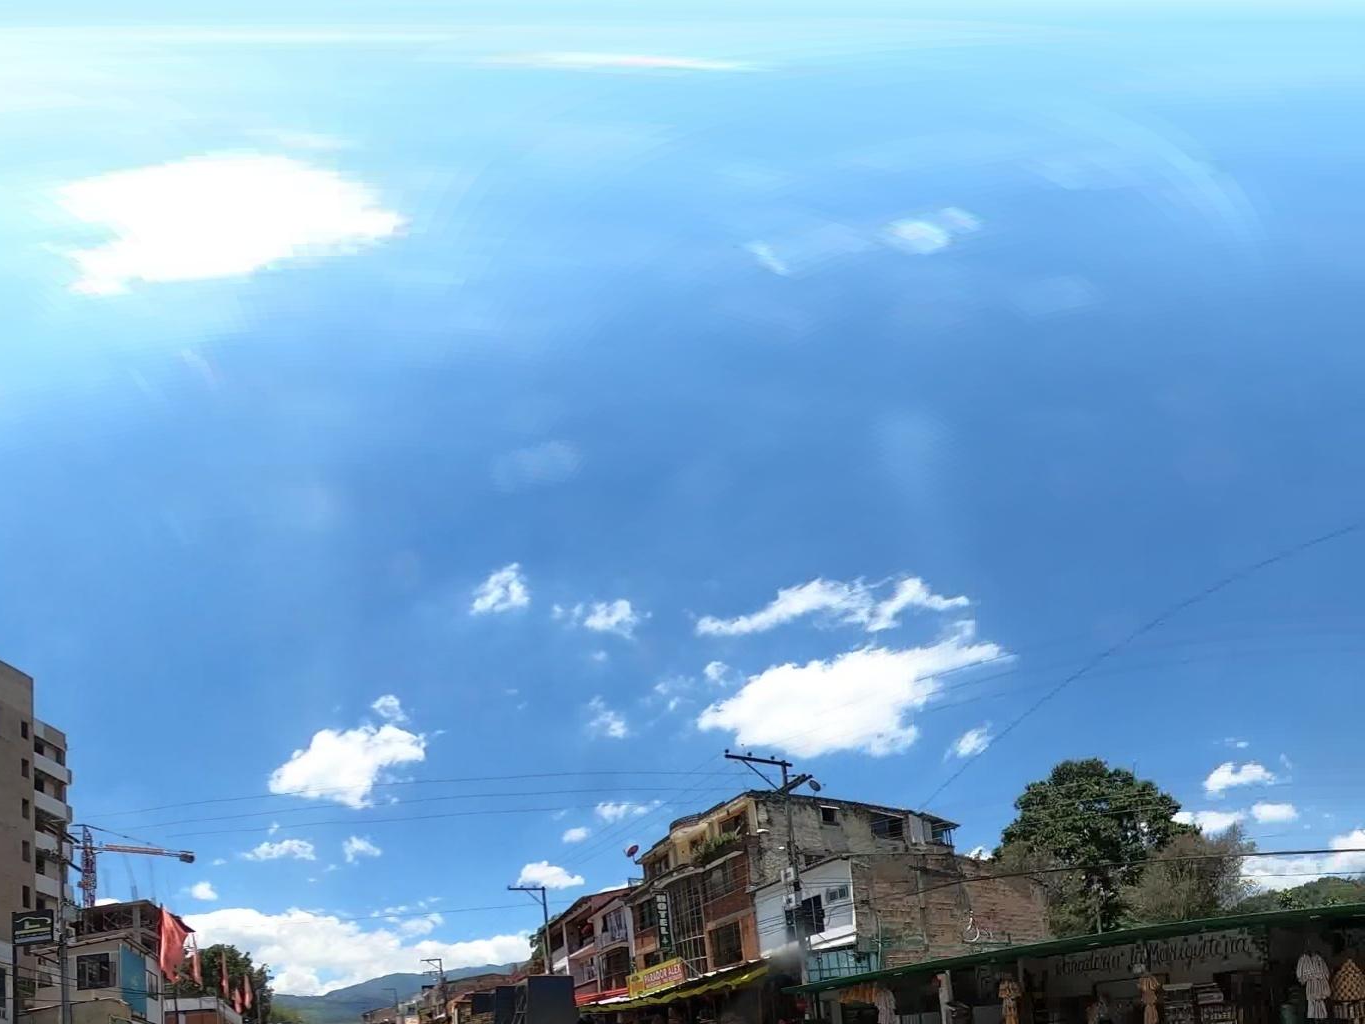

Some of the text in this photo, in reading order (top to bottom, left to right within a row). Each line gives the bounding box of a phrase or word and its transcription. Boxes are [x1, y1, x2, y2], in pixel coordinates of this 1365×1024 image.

[656, 894, 669, 935] HOTEL
[644, 967, 667, 984] PARADOR
[668, 963, 682, 976] ALEX
